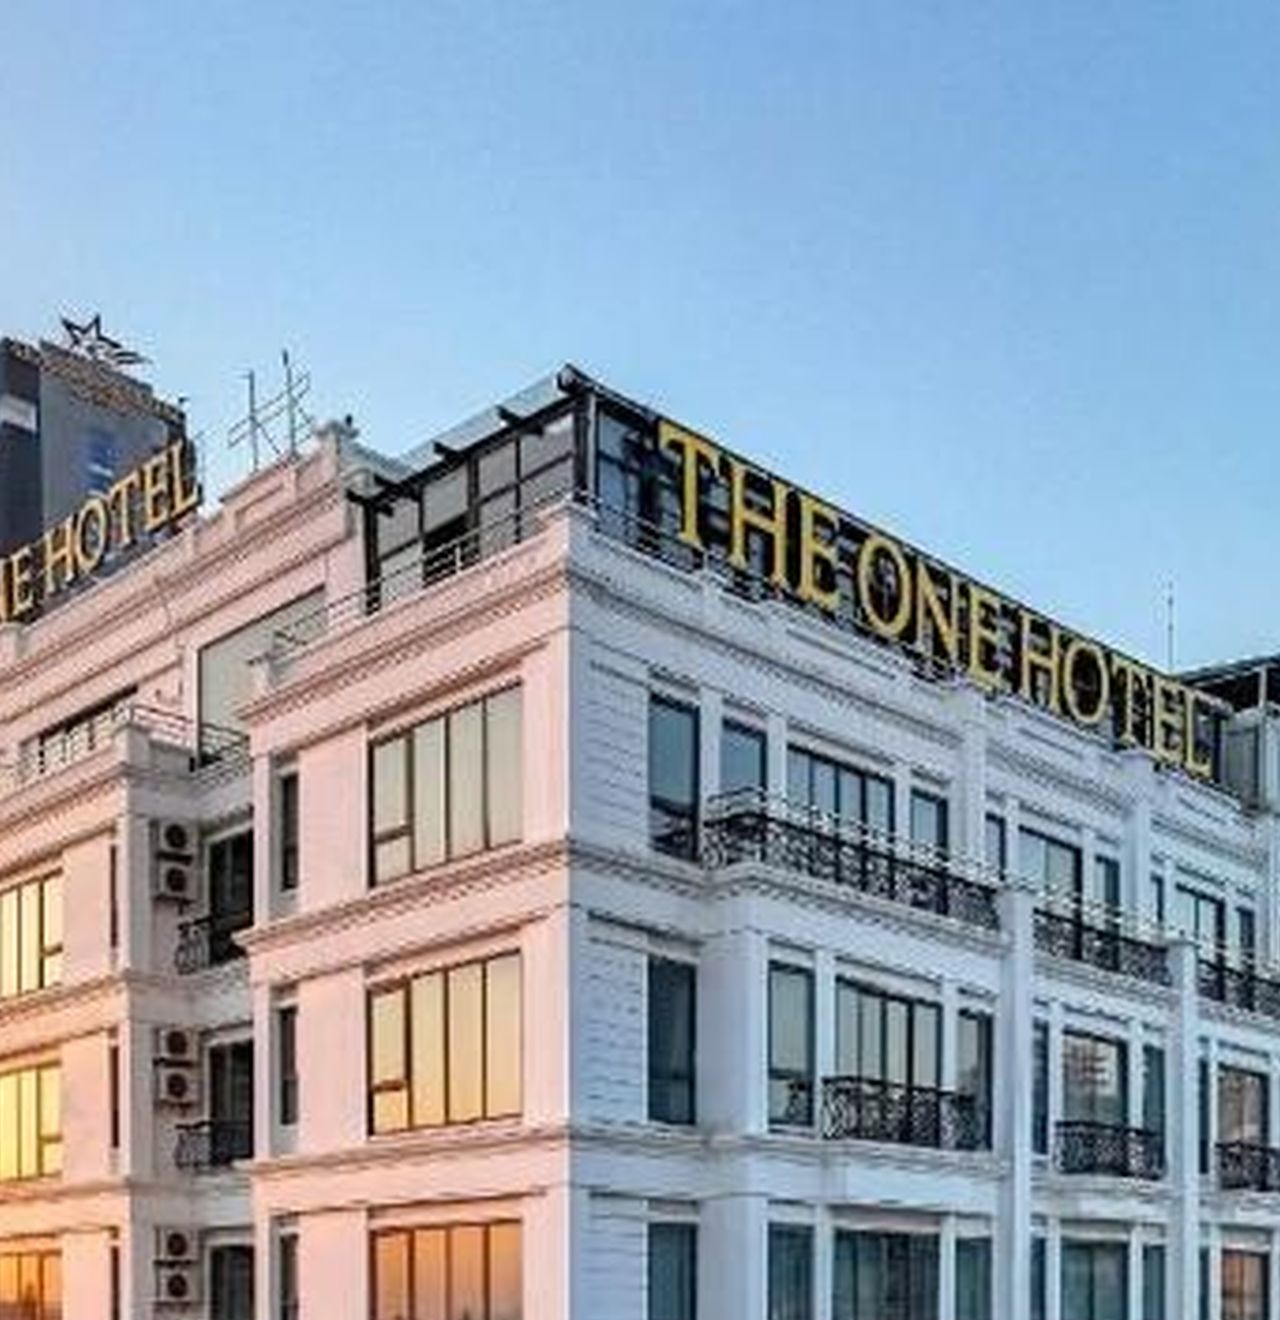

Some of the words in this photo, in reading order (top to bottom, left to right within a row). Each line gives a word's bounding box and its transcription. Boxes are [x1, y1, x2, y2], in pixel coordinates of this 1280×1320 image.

[43, 441, 197, 592] HOTEL
[657, 420, 842, 608] THE
[856, 532, 1006, 687] ONE
[1021, 611, 1215, 776] HOTEL
